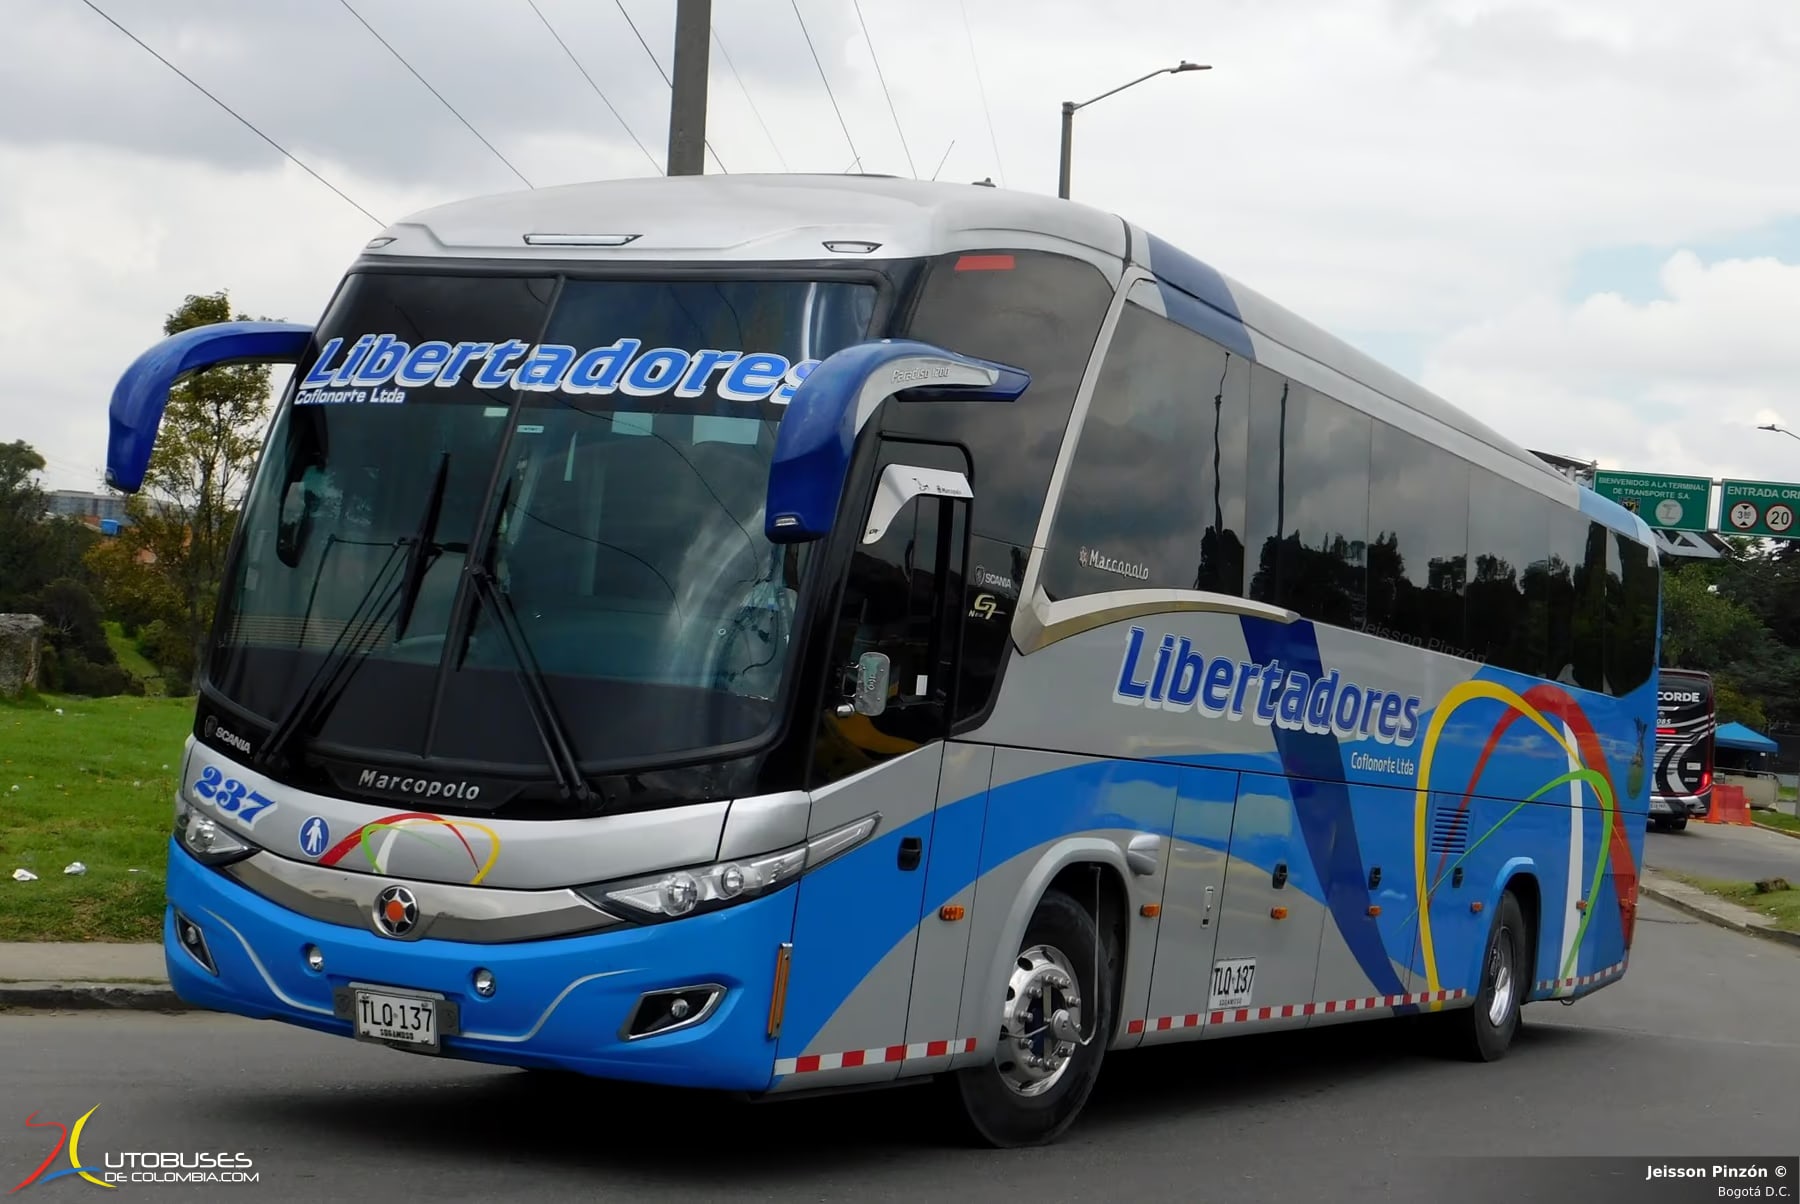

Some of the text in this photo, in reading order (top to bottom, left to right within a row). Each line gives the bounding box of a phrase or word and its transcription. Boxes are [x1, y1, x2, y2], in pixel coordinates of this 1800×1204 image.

[369, 387, 406, 404] Ltda
[1598, 476, 1650, 487] BIENVENIDOS
[1668, 482, 1706, 491] TERMINAL
[1727, 486, 1779, 498] ENTRADA
[1612, 487, 1623, 495] DE
[1624, 488, 1675, 499] TRANSPORTE
[1771, 511, 1789, 525] 20
[1089, 549, 1149, 581] Marcopolo
[984, 573, 1012, 589] SCANIA
[1112, 625, 1421, 747] Libertadores
[215, 726, 251, 754] SCANIA
[1396, 757, 1414, 776] Ltda
[358, 769, 481, 801] Marcopolo
[193, 765, 278, 832] 237
